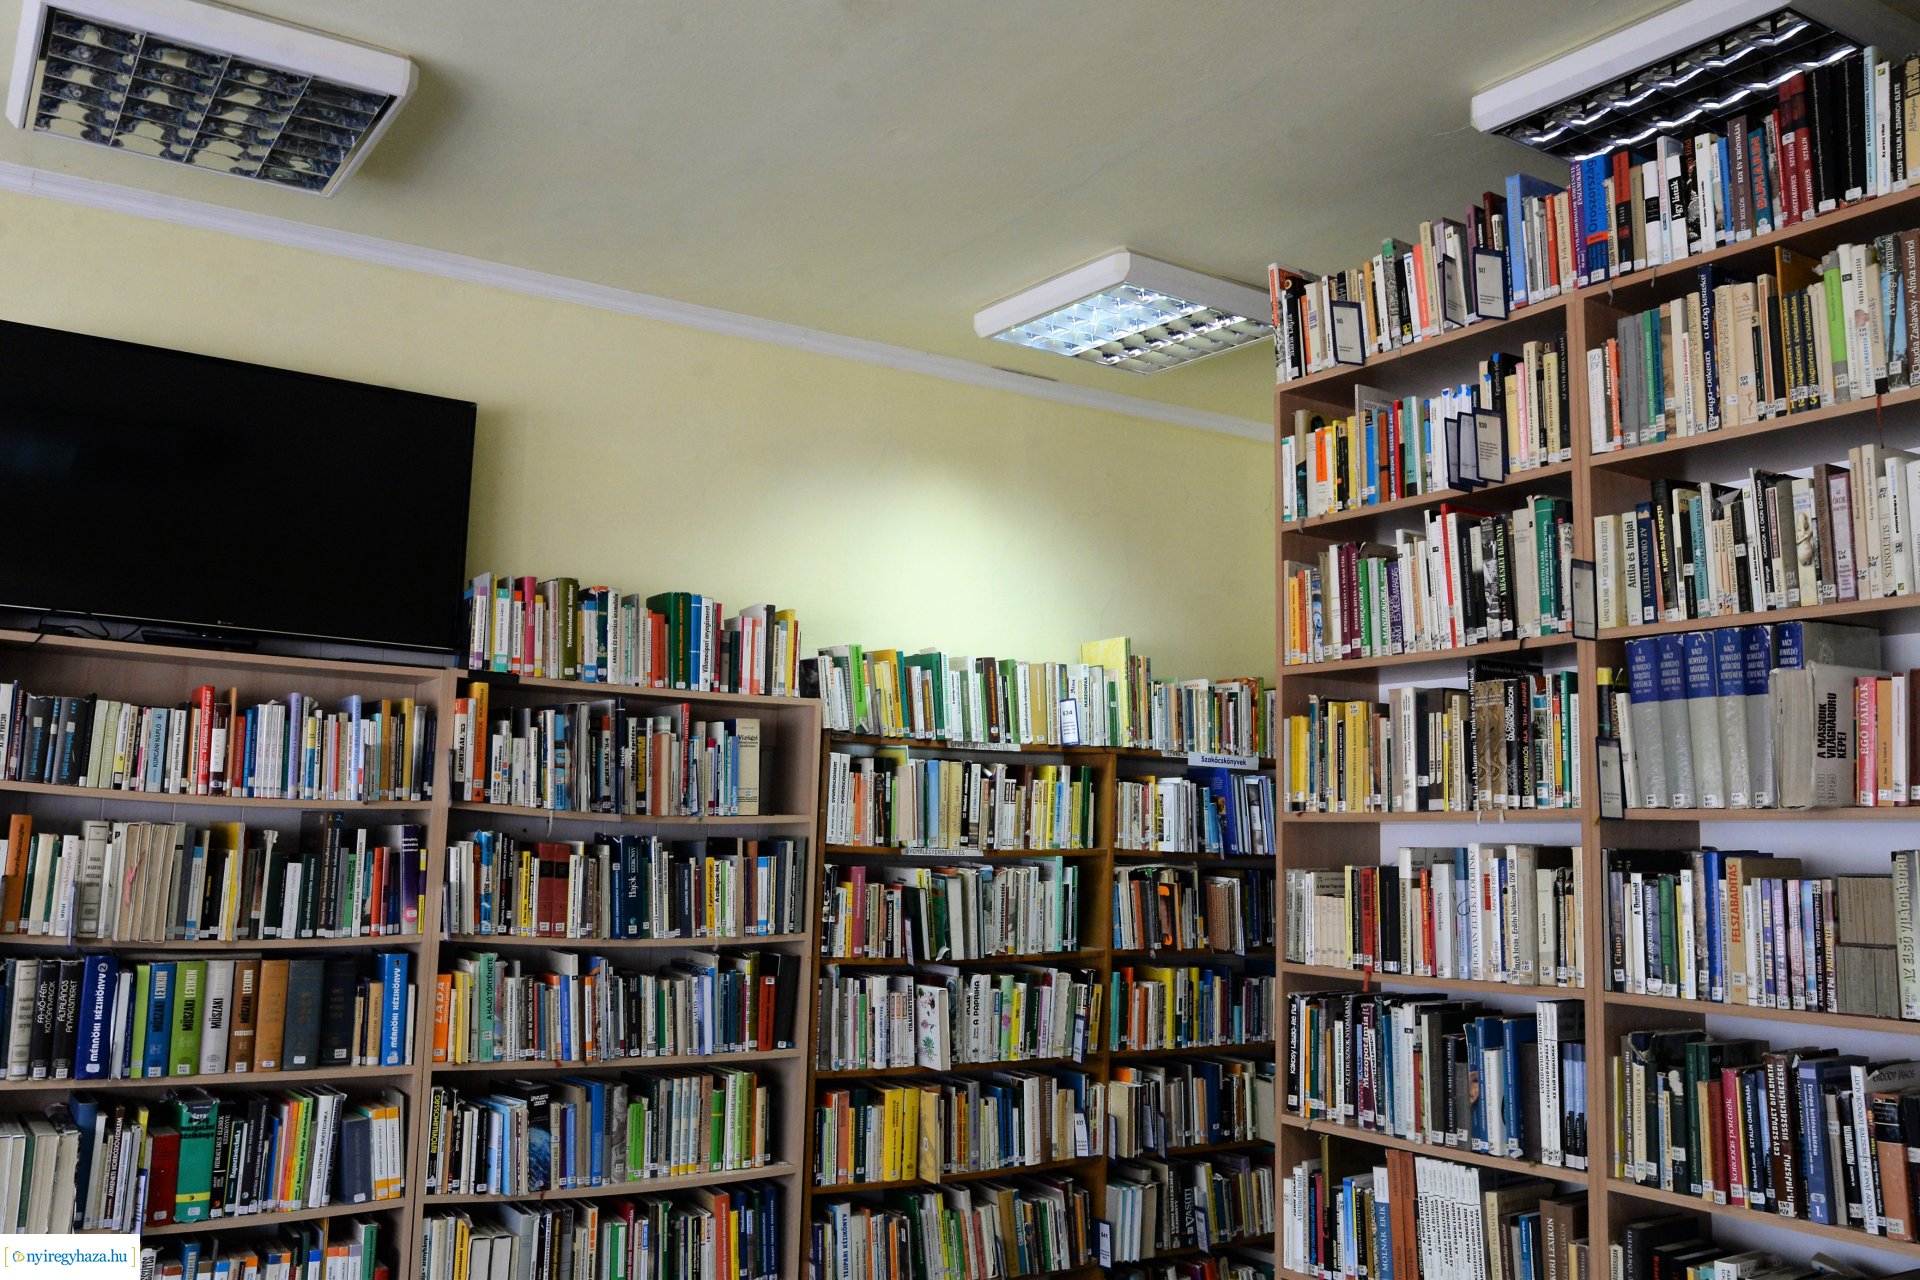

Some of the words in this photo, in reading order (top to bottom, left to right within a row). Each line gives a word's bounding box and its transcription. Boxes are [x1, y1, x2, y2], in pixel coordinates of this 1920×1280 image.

[1751, 136, 1767, 209] BUHARIN
[1586, 160, 1598, 232] Oroszország
[1908, 271, 1916, 294] Afrika
[1624, 521, 1635, 548] hunjai
[1883, 524, 1893, 577] SUETONIUS
[1627, 552, 1635, 561] és
[1641, 540, 1649, 567] ORION
[1627, 564, 1636, 588] Attila
[1860, 682, 1868, 726] FALVAK
[628, 876, 638, 898] Hajók
[1728, 864, 1740, 943] FELSZABADÍTÁS
[1614, 937, 1622, 965] Ciano
[151, 971, 167, 999] LEXIKON
[186, 970, 197, 998] LEXIKON
[242, 969, 254, 994] LEXIKON
[392, 968, 402, 1010] KÉZIKÖNYV
[1903, 970, 1914, 984] AZ
[56, 980, 68, 1022] ÁLTALÁNOS
[66, 980, 77, 1033] ANYAGISMERET
[93, 974, 106, 1020] KÉZIKÖNYV
[435, 982, 444, 1023] LADA
[90, 1022, 101, 1061] MÉRNÖKI
[391, 1013, 400, 1048] MÉRNÖKI
[1770, 1108, 1779, 1140] SZOVJET
[1772, 1142, 1780, 1156] EGY
[1380, 1231, 1388, 1271] MOLNÁR
[1547, 1217, 1555, 1257] LEXIKON
